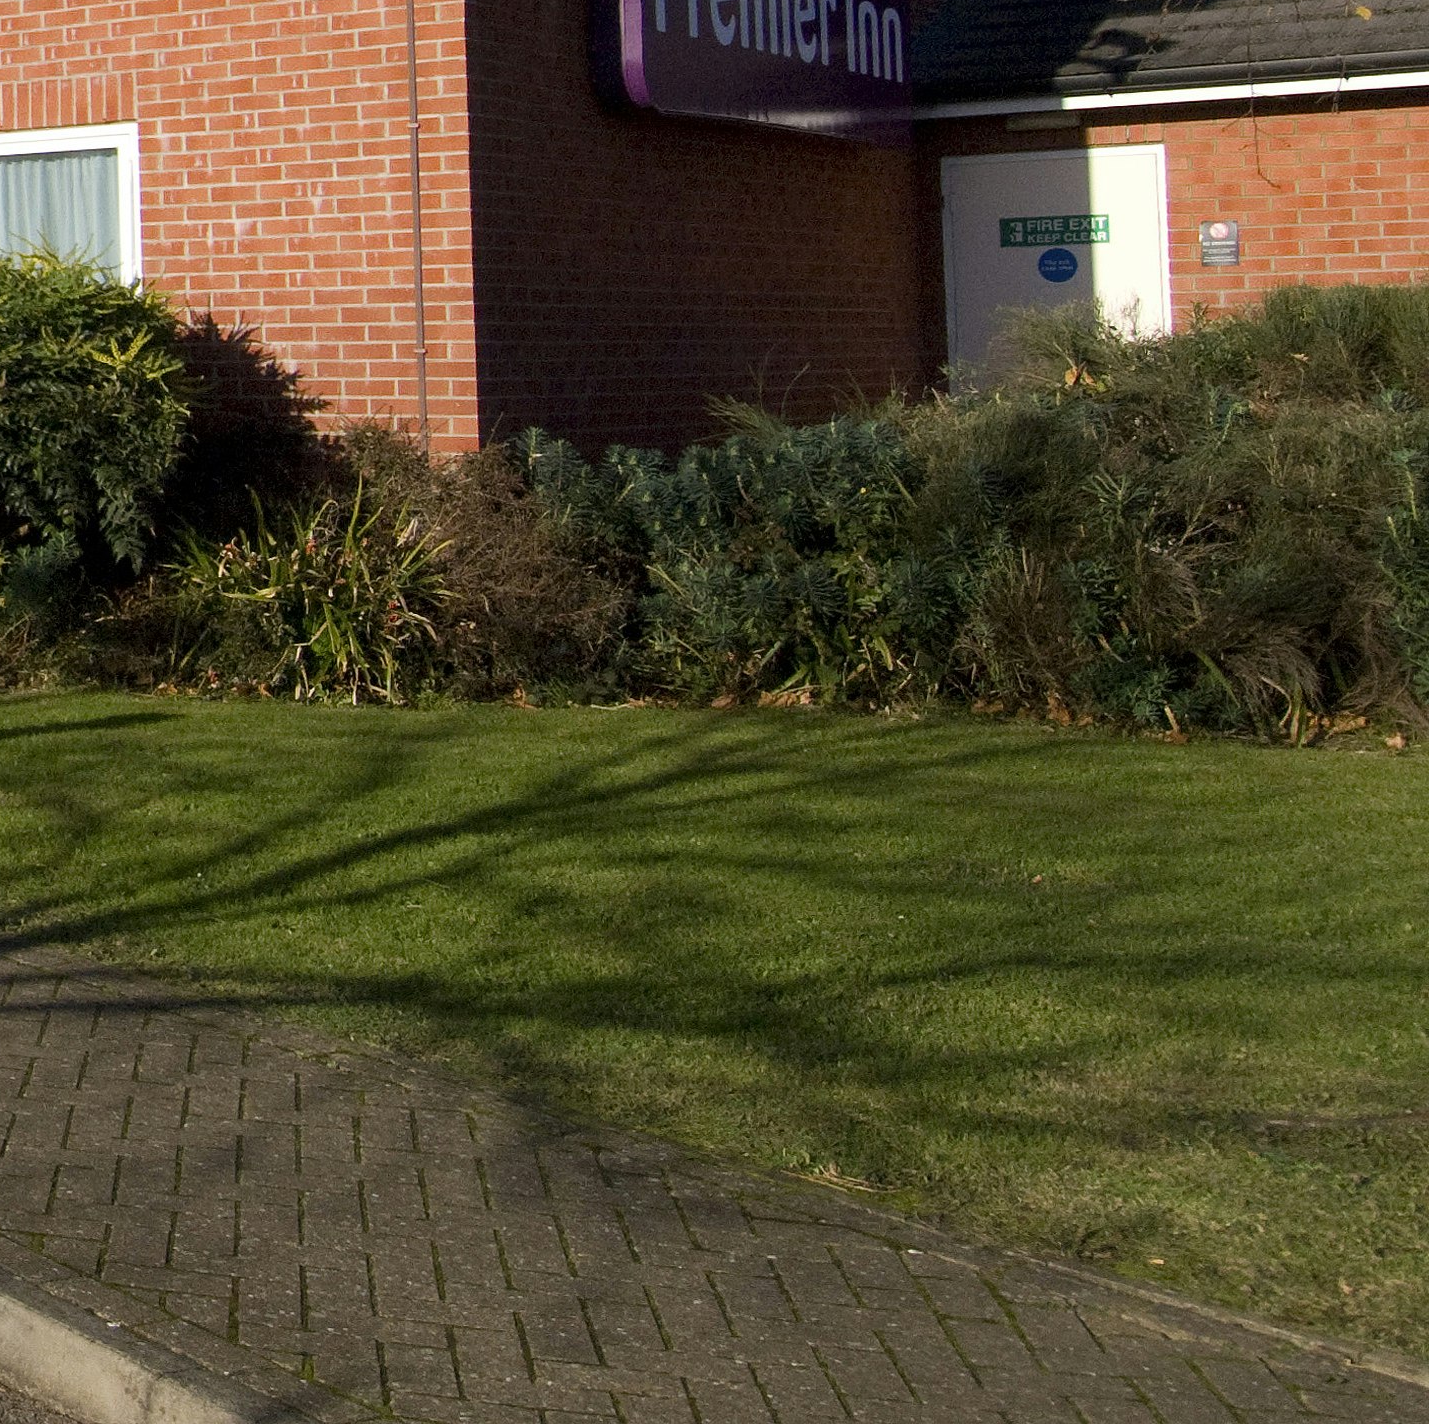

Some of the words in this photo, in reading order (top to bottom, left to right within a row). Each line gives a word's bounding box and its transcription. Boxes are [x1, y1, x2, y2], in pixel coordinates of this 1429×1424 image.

[1026, 219, 1064, 232] FIRE
[1069, 217, 1108, 230] EXIT
[1027, 234, 1060, 243] KEEP
[1063, 231, 1108, 242] CLEAR
